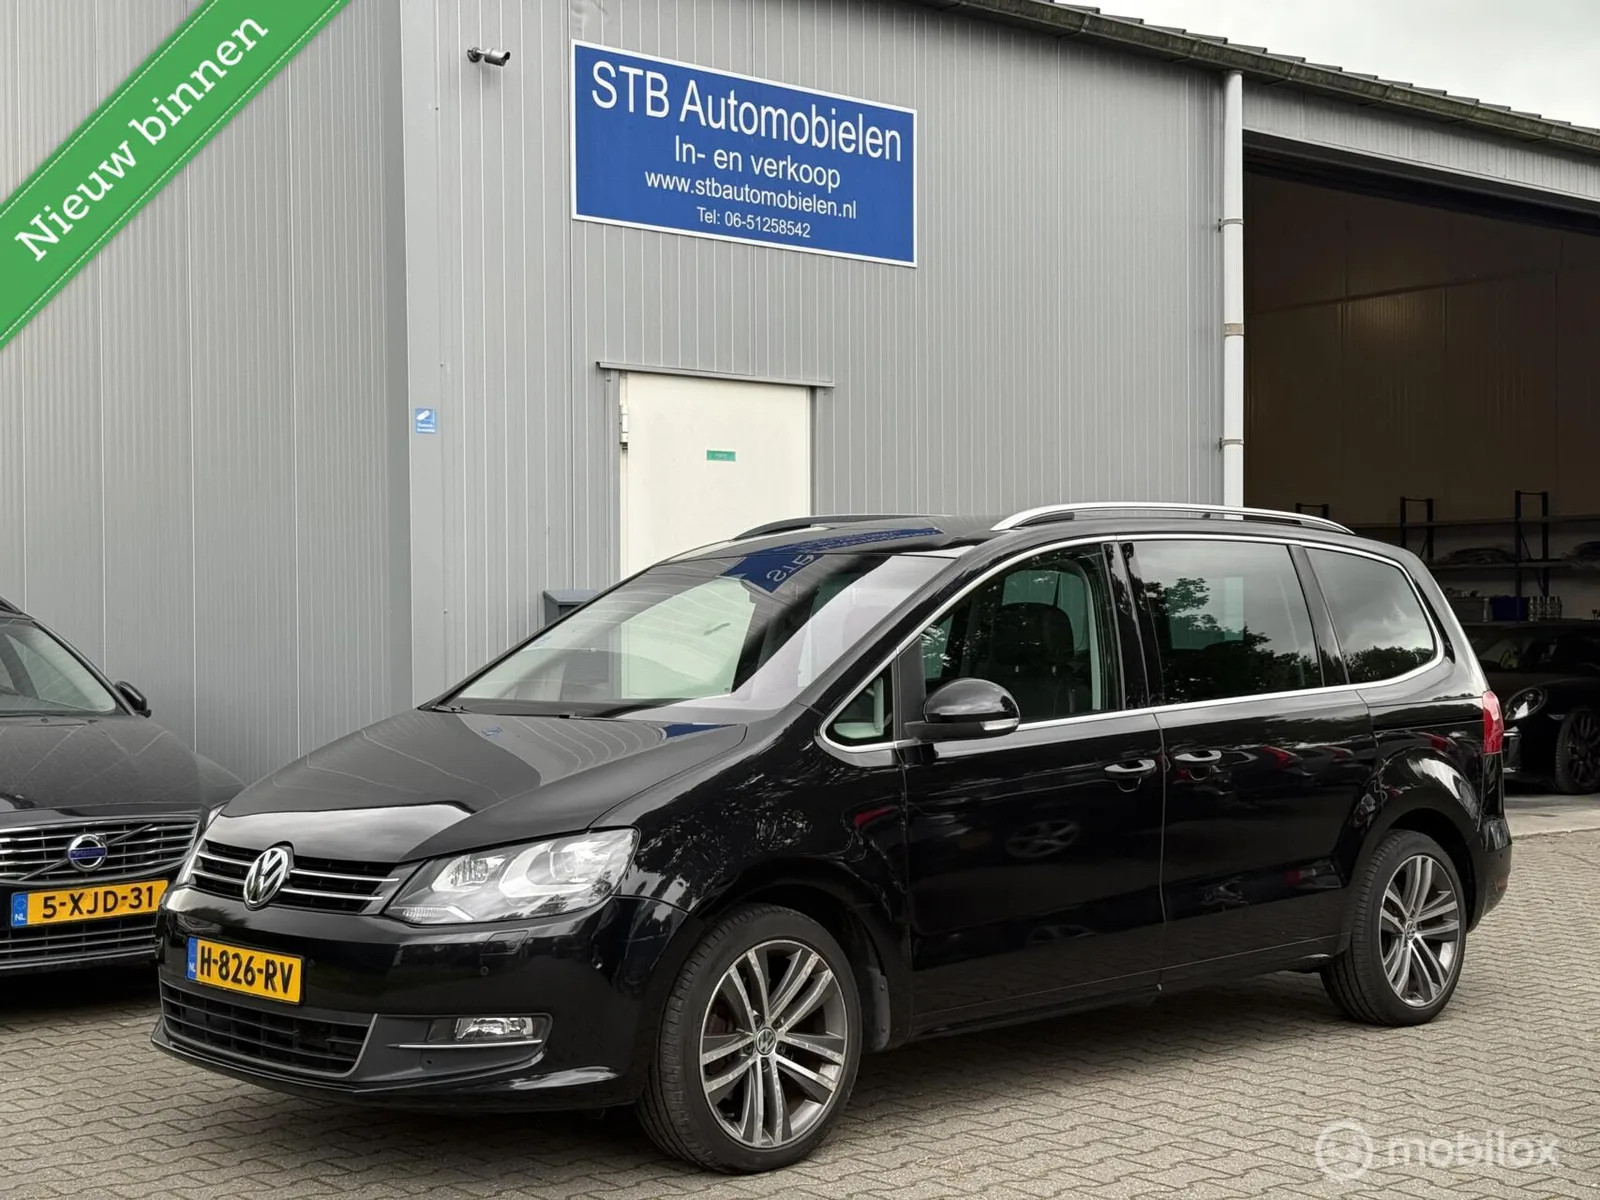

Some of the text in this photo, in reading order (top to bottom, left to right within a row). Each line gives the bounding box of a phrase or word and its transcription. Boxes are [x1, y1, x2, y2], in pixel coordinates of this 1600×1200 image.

[592, 60, 902, 162] STB Automobielen
[675, 135, 841, 193] In- en verkoop
[645, 170, 858, 220] www.stbautomobielen.nl
[697, 207, 811, 238] Tel: 06-51258542
[14, 913, 27, 922] NL
[42, 885, 154, 919] 5-XJD-31
[200, 945, 294, 994] H-826-RV
